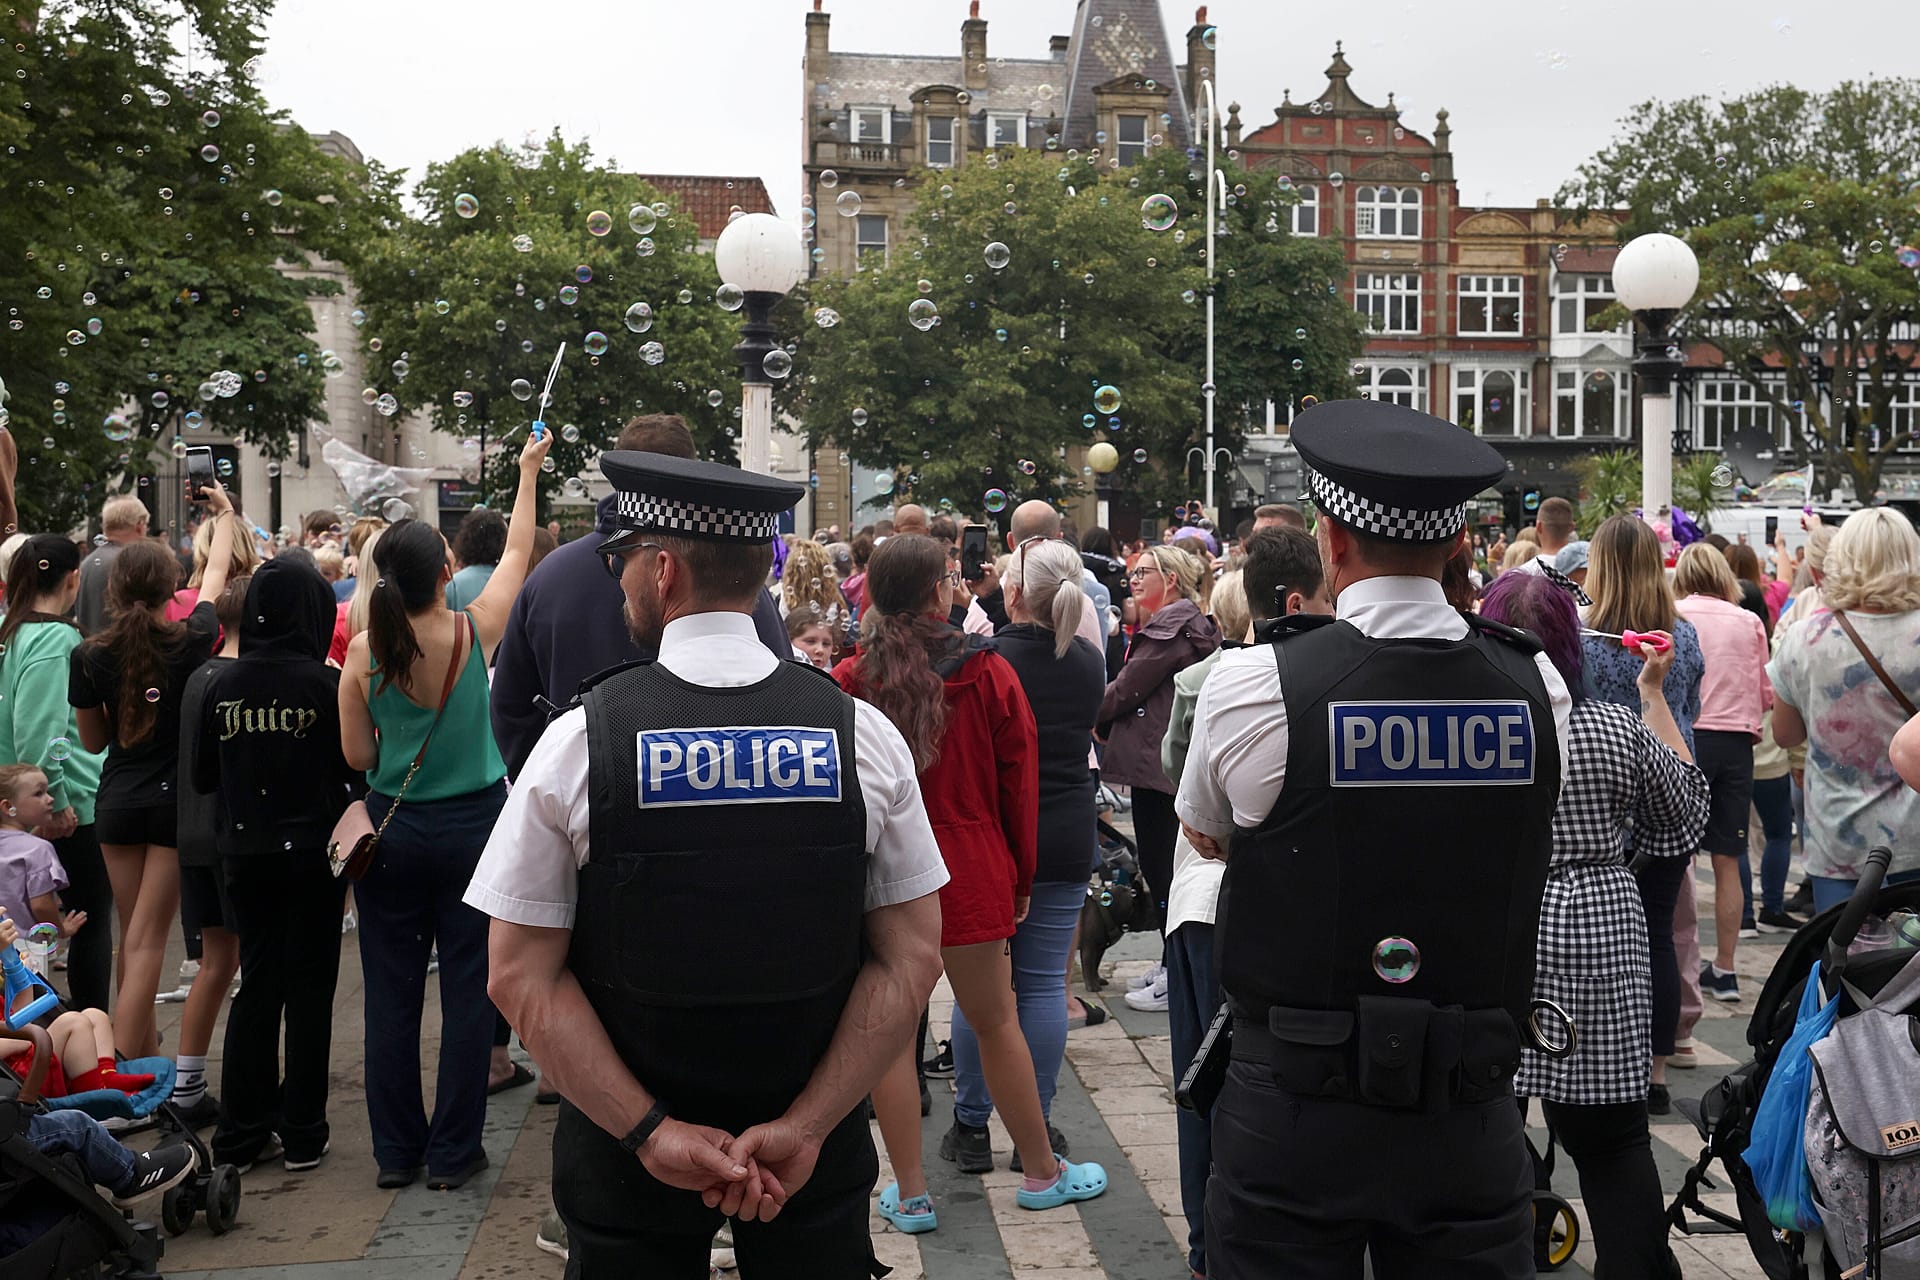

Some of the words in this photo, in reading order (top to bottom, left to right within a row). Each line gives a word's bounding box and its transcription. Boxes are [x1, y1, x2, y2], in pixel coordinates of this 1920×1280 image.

[215, 697, 318, 741] Juicy
[1342, 715, 1525, 770] POLICE
[649, 738, 831, 792] POLICE
[1886, 1126, 1919, 1143] 101
